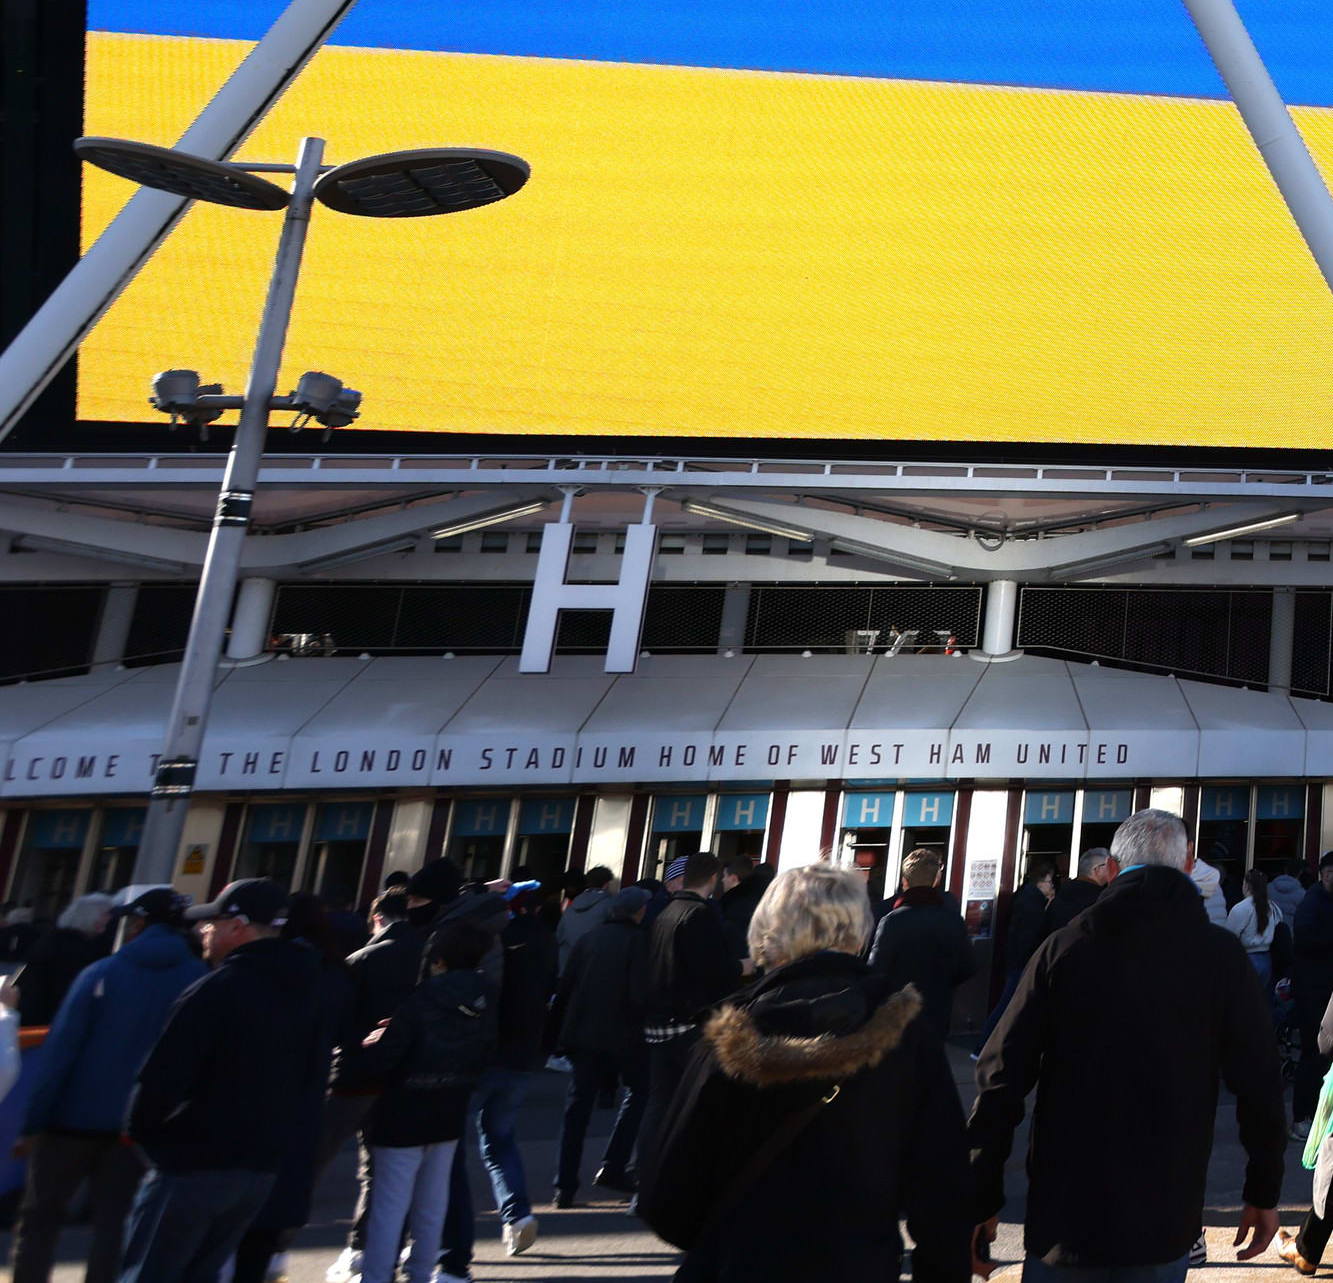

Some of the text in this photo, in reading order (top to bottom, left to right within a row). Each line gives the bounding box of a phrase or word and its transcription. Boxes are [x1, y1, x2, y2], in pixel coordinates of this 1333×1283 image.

[519, 522, 659, 674] H
[219, 751, 286, 775] THE
[310, 748, 452, 774] LONDON
[480, 746, 636, 770] STADIUM
[658, 745, 747, 768] HOME
[767, 745, 800, 766] OF
[820, 744, 904, 766] WEST
[929, 743, 992, 765] HAM
[1016, 743, 1129, 765] UNITED
[670, 800, 693, 827] H
[733, 799, 756, 825] H
[860, 797, 881, 823] H
[920, 797, 941, 822] H
[1041, 794, 1061, 820] H
[1099, 793, 1118, 818] H
[1215, 790, 1233, 816] H
[1271, 790, 1290, 815] H
[474, 804, 498, 831] H
[538, 804, 563, 830] H
